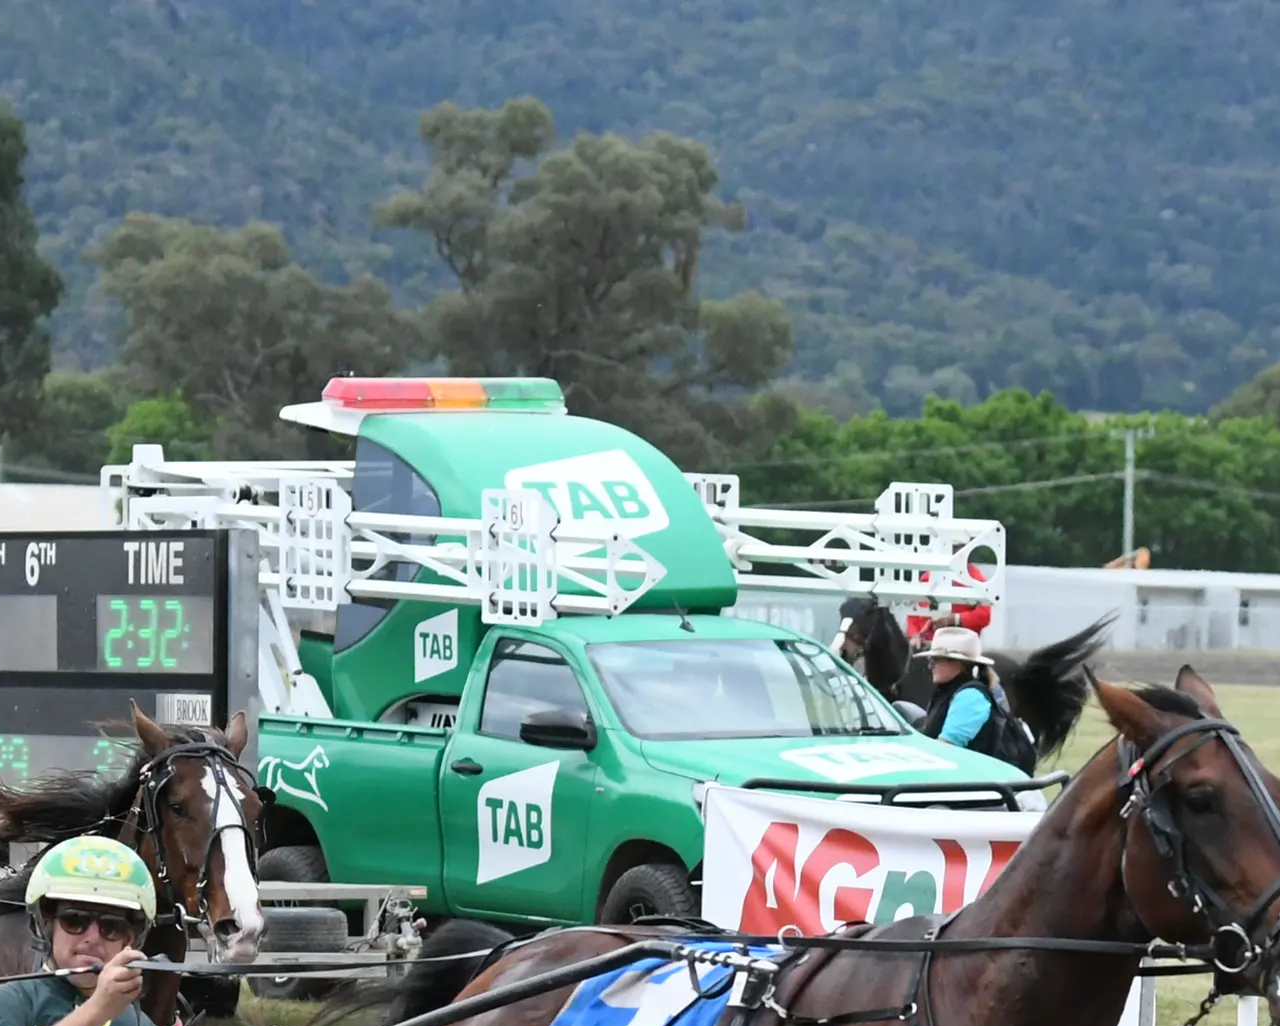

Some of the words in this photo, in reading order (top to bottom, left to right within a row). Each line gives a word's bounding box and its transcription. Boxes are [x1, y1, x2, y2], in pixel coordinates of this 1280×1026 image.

[521, 480, 650, 520] TAB
[123, 541, 185, 585] TIME
[419, 631, 454, 662] TAB
[176, 699, 208, 721] BROOK
[485, 796, 544, 850] TAB
